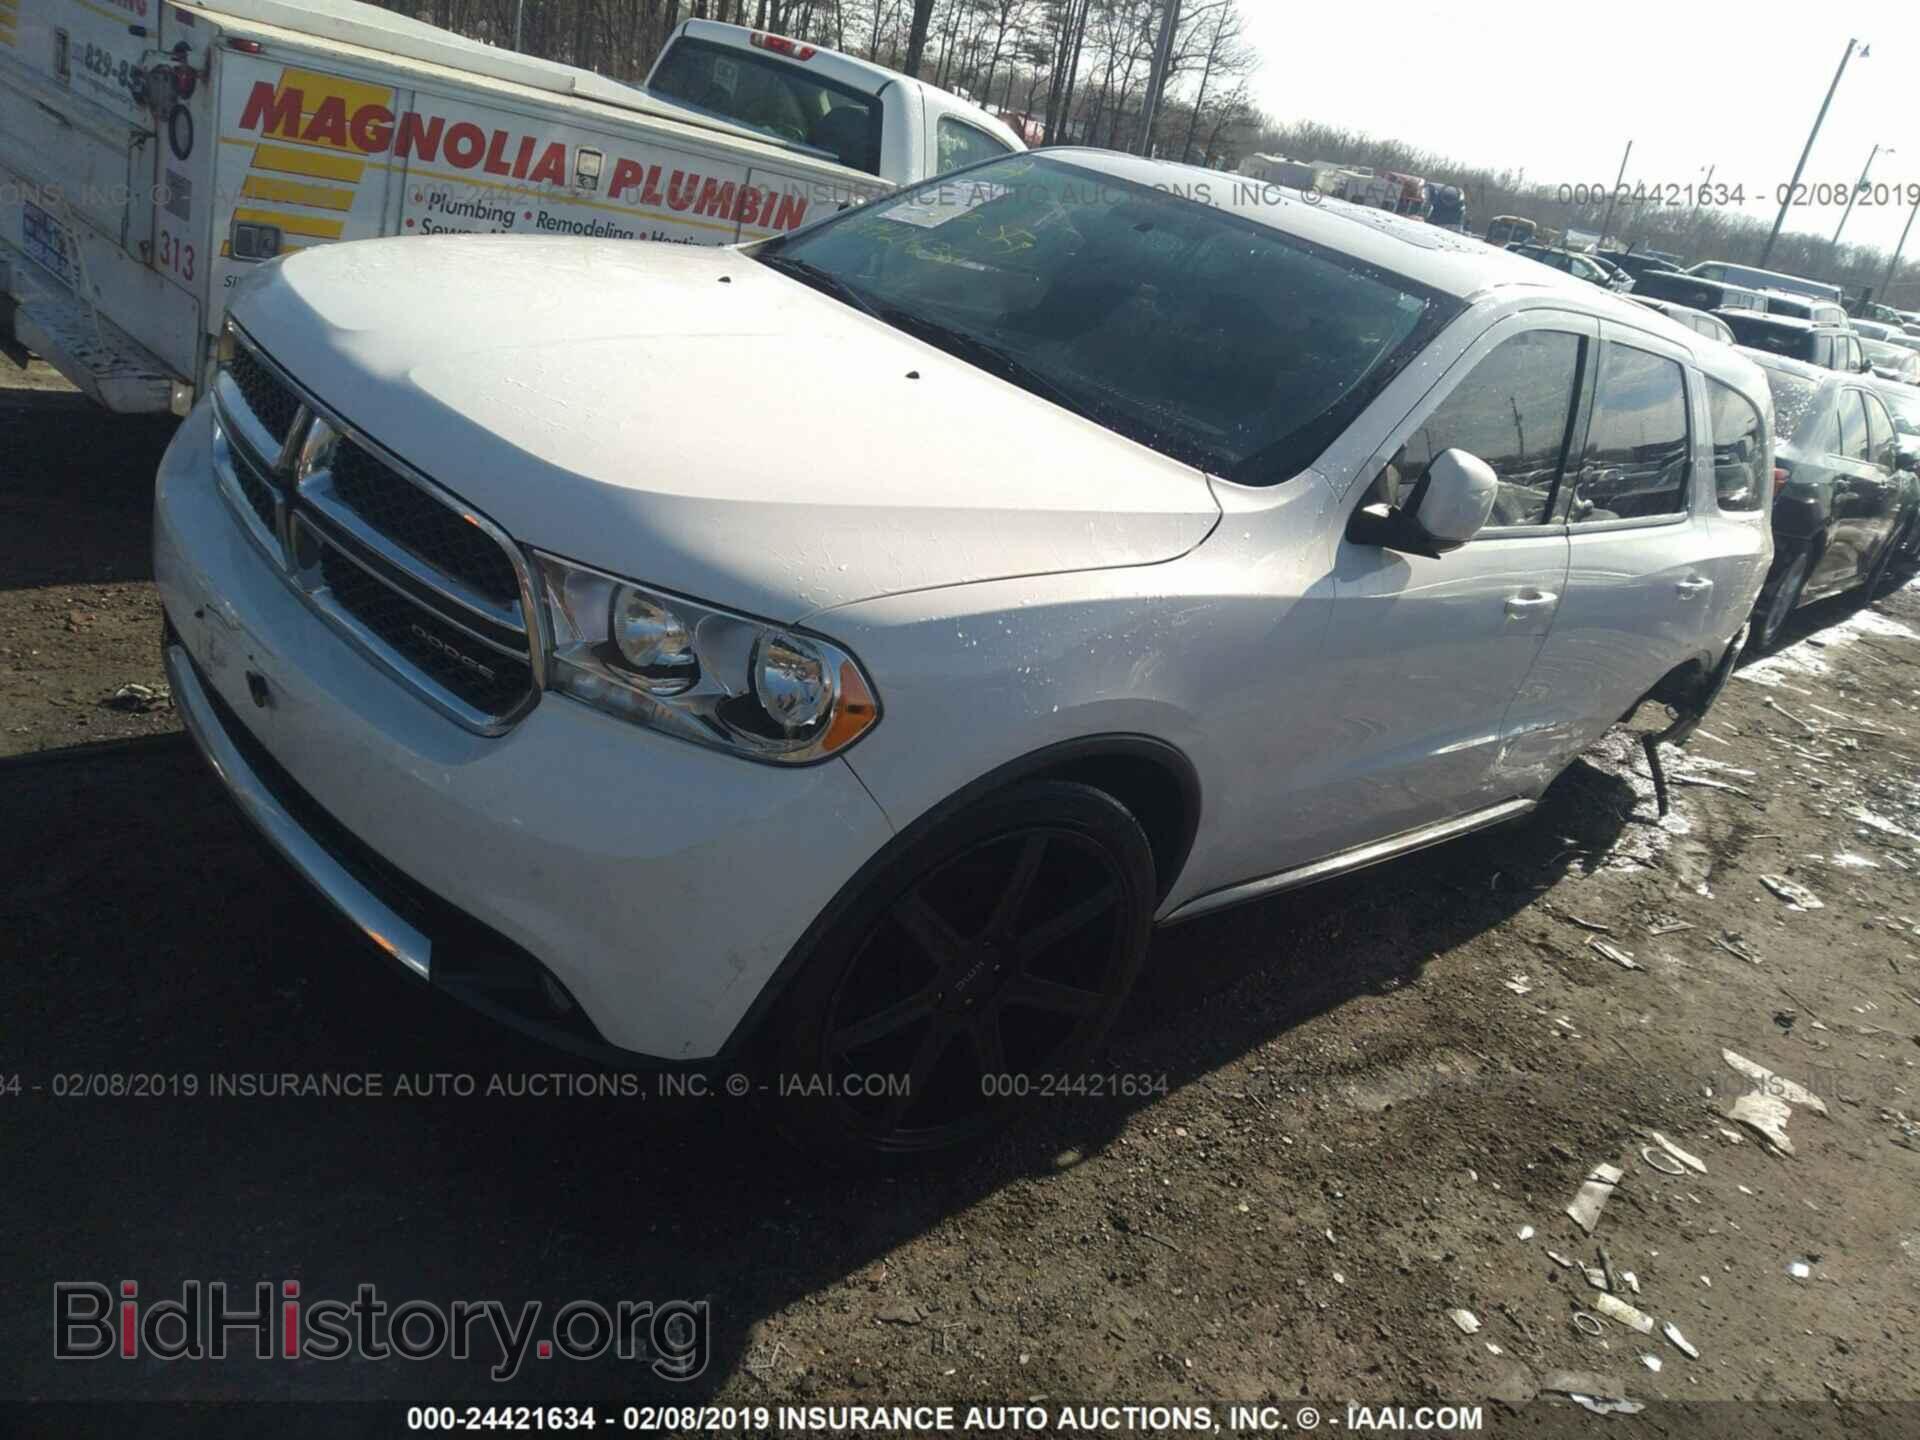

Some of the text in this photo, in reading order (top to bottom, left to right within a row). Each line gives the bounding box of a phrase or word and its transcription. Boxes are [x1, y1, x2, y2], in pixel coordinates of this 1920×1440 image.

[239, 80, 568, 187] MAGNOLIA
[428, 192, 515, 228] Plumbing
[160, 230, 195, 281] 313
